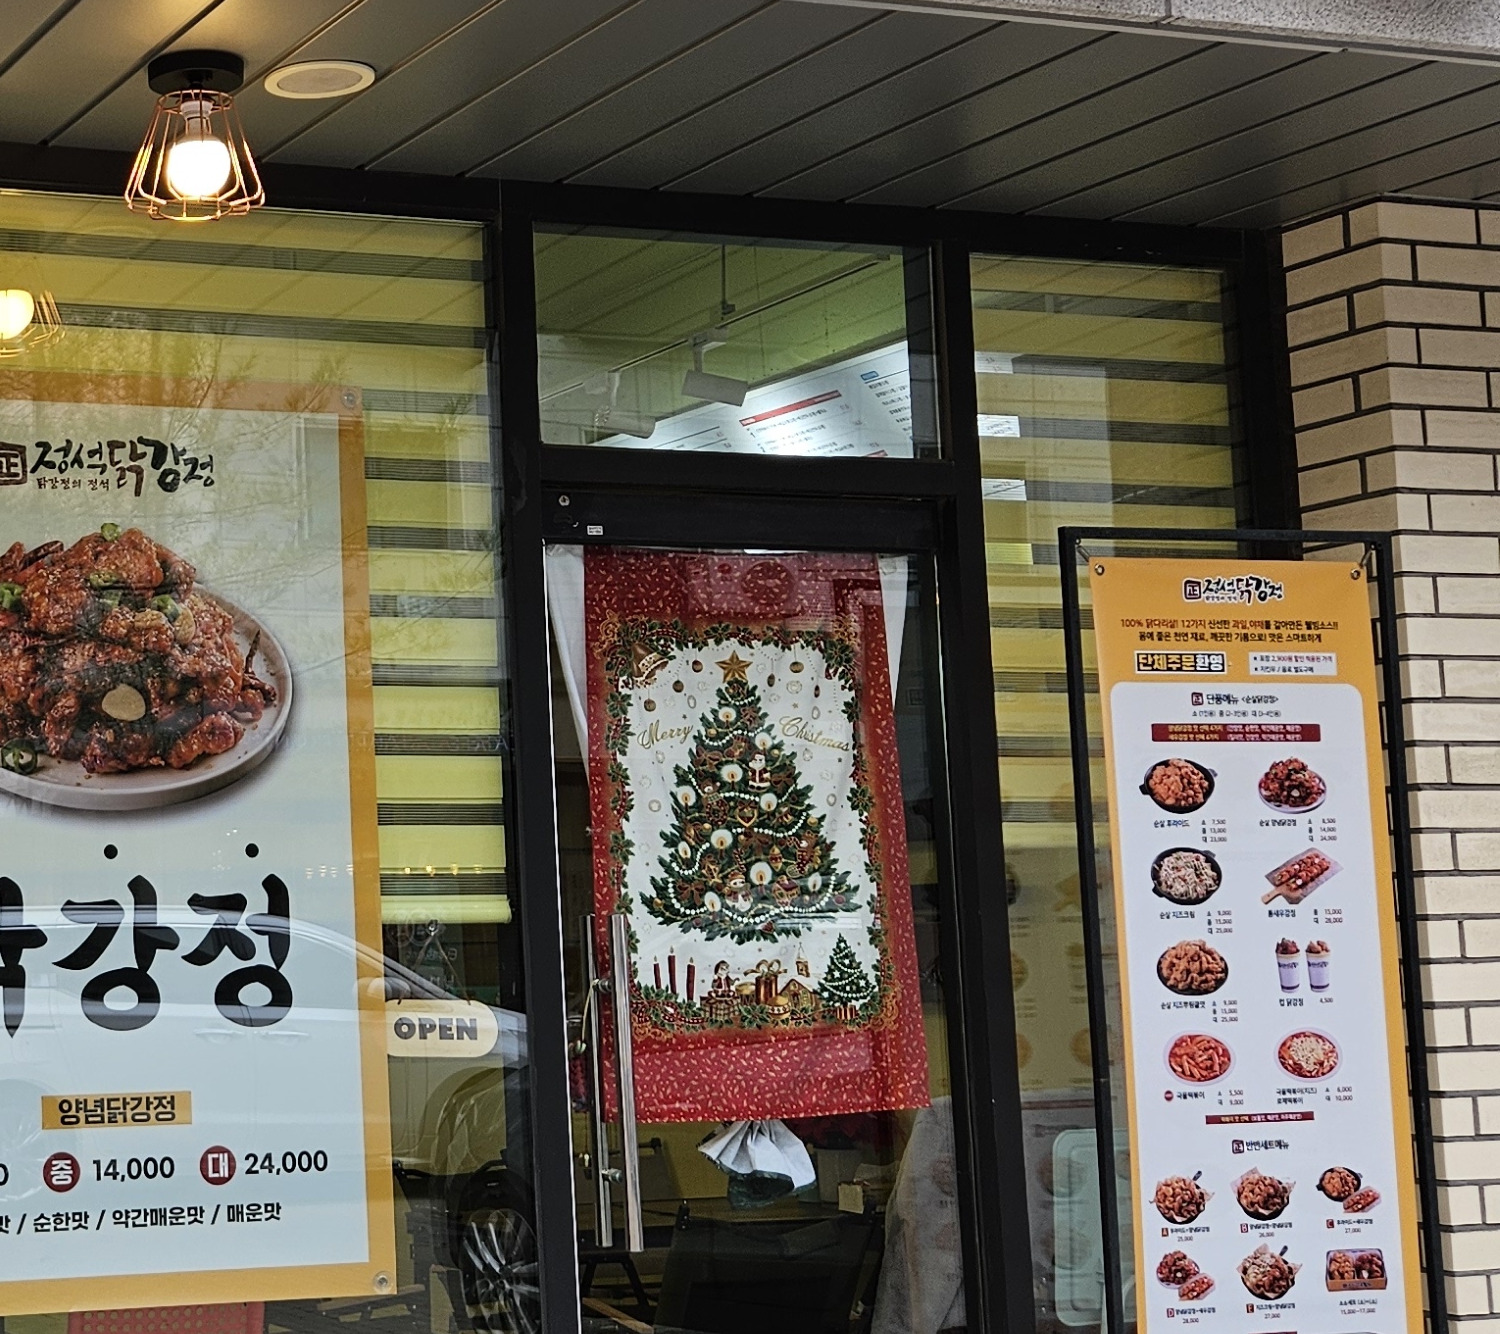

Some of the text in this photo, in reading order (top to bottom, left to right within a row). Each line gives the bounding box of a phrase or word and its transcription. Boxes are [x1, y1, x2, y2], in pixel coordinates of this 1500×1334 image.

[30, 436, 215, 497] 정석닭강정
[36, 477, 110, 491] 닭강정의 정석
[1203, 576, 1284, 603] 정석닭강정
[1121, 618, 1144, 628] 100%
[1181, 619, 1206, 629] 12가지
[1208, 619, 1230, 629] 신선한
[1173, 631, 1189, 642] 천연
[1210, 632, 1232, 642] 깨끗한
[1285, 633, 1322, 643] 스마트하게
[1138, 653, 1223, 671] 단체주문환영
[1206, 694, 1239, 705] 단품메뉴
[637, 716, 850, 751] Merry Christmas
[394, 1017, 478, 1040] OPEN
[58, 1095, 176, 1126] 양념닭강정
[50, 1160, 73, 1186] 중
[93, 1157, 175, 1183] 14,000
[207, 1152, 229, 1179] 대
[244, 1150, 328, 1176] 24,000
[17, 1214, 27, 1234] /
[32, 1210, 90, 1233] 순한맛
[96, 1210, 106, 1232] /
[112, 1206, 205, 1229] 약간매운맛
[211, 1204, 220, 1225] /
[227, 1201, 281, 1223] 매운맛
